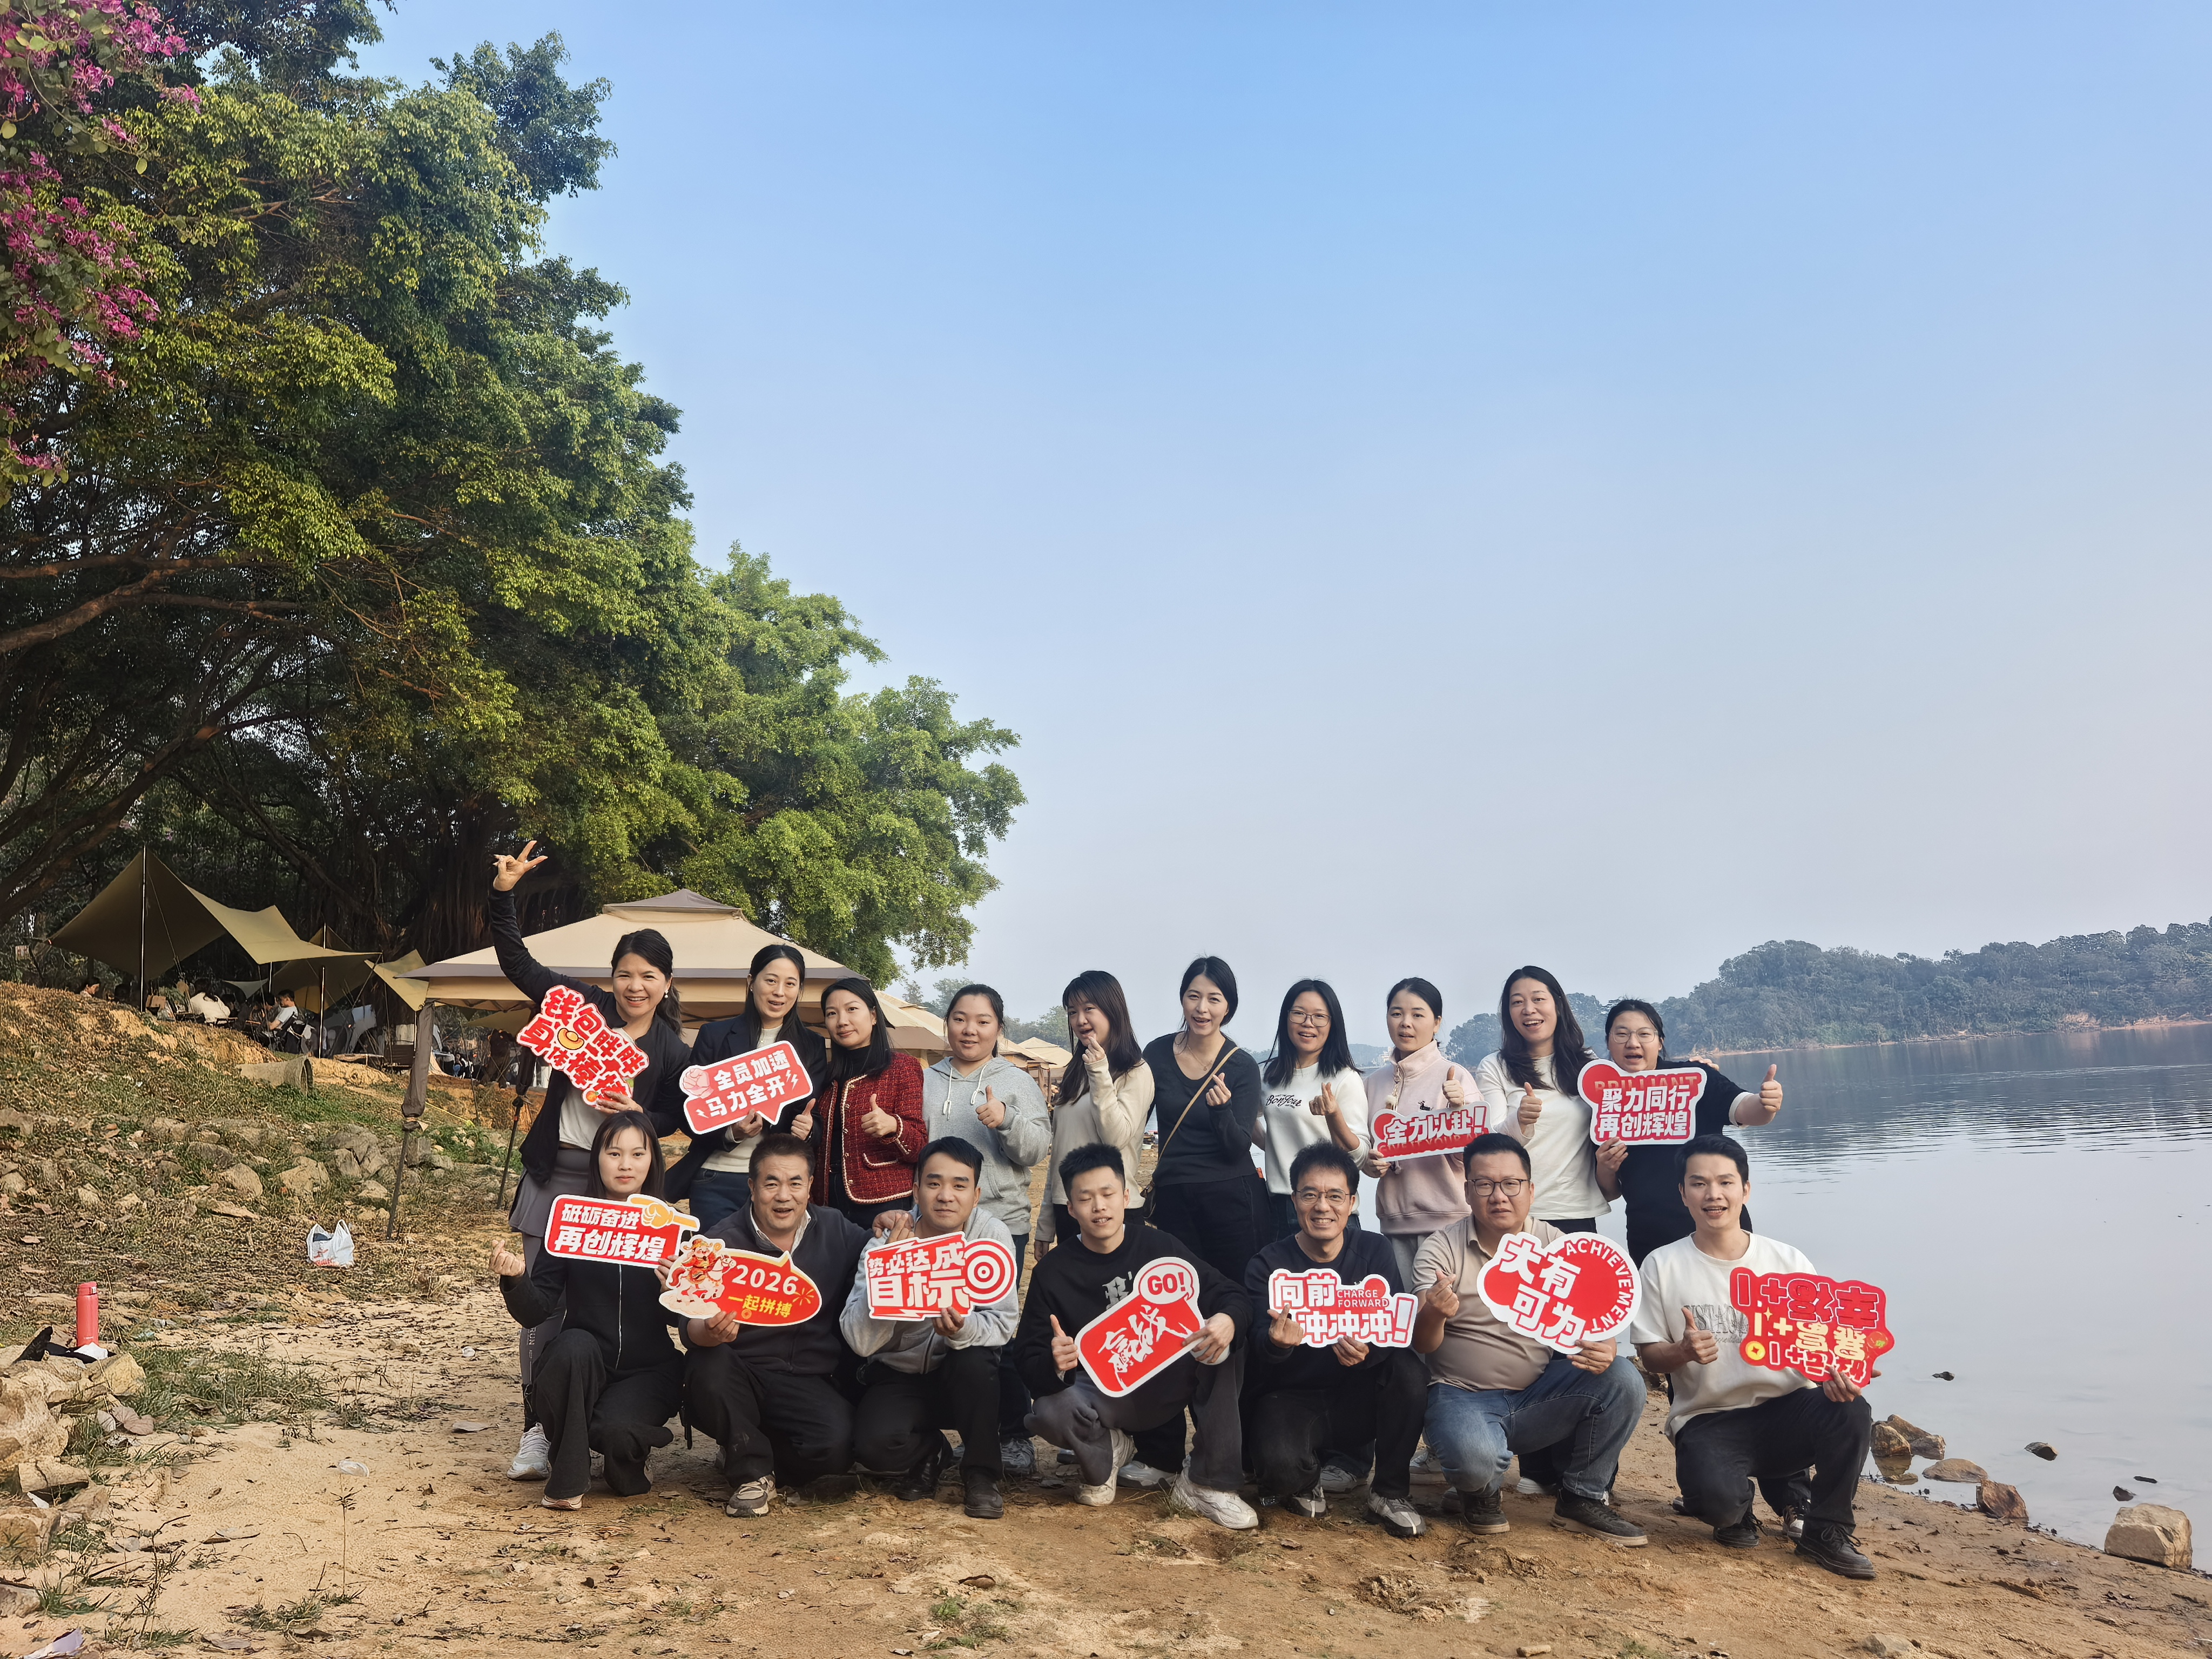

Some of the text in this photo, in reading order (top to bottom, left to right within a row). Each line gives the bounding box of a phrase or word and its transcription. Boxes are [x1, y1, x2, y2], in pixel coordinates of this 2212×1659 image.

[544, 987, 645, 1075] 钱包胖胖
[714, 1049, 790, 1091] 全员加速
[706, 1079, 786, 1118] 马力全开
[1602, 1084, 1690, 1112] 聚力同行
[1598, 1111, 1688, 1138] 再创辉煌
[562, 1204, 639, 1230] 砥砺奋进
[555, 1225, 666, 1262] 再创辉煌
[732, 1265, 798, 1295] 2026
[870, 1269, 969, 1309] 目标
[1147, 1272, 1186, 1295] GO!
[1274, 1275, 1336, 1307] 向前
[1337, 1289, 1378, 1298] CHARGE
[1566, 1241, 1632, 1332] ACHIEVEMENT
[728, 1294, 793, 1318] 一起拼搏
[1338, 1298, 1389, 1307] FORWARD
